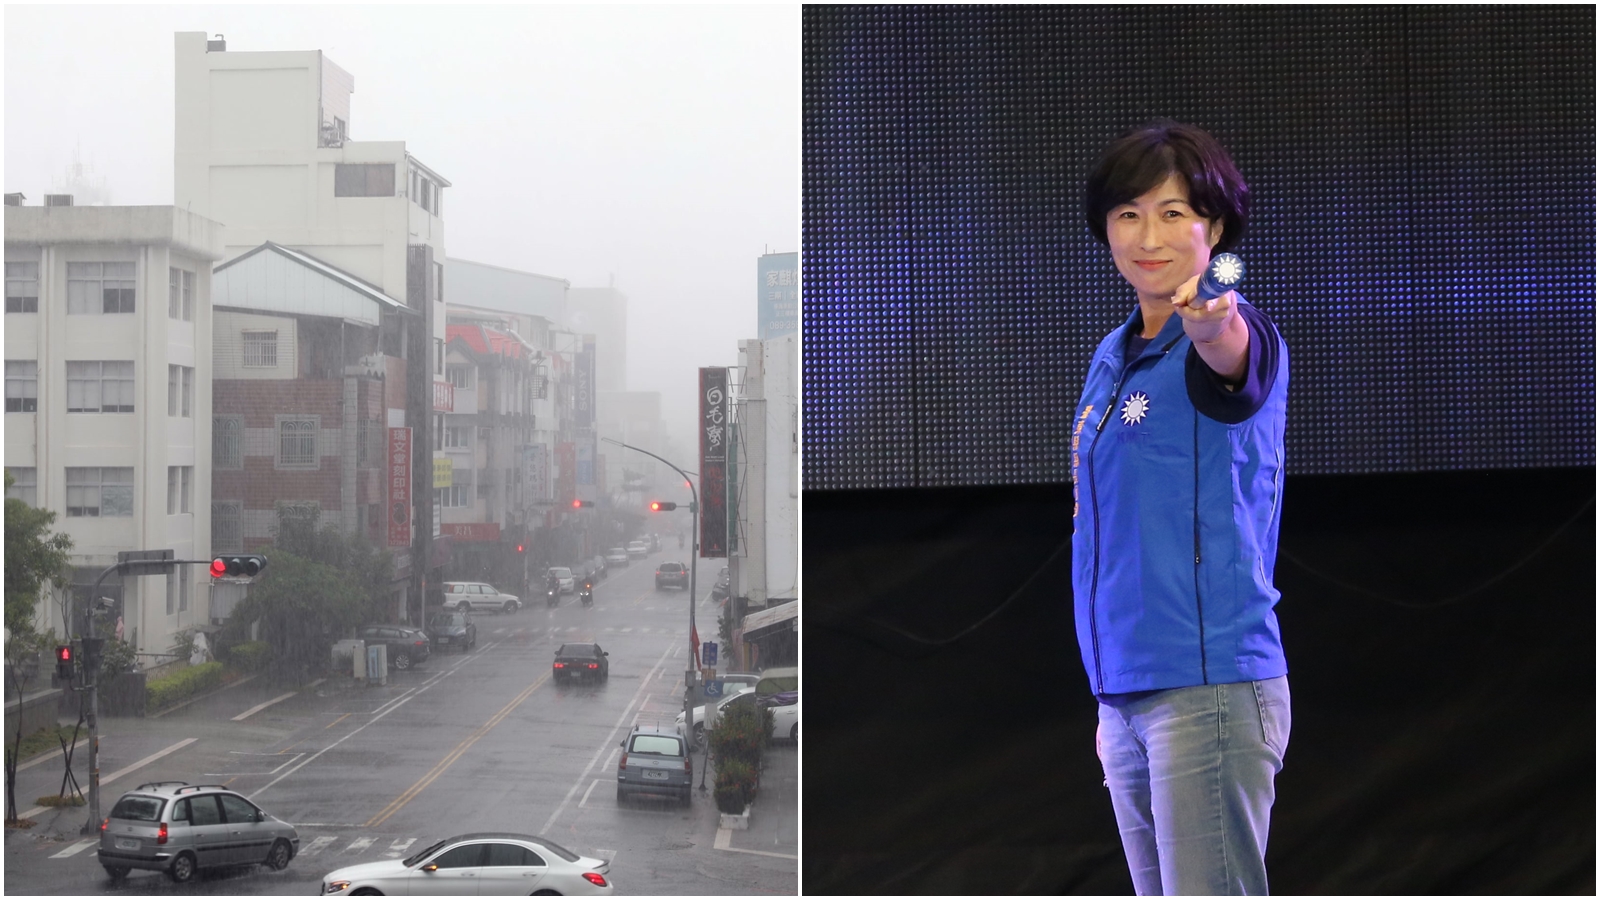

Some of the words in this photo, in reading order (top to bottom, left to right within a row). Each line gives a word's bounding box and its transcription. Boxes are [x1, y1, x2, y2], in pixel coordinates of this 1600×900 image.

[579, 370, 588, 412] SONY
[393, 429, 406, 500] 瑞文堂刻印社
